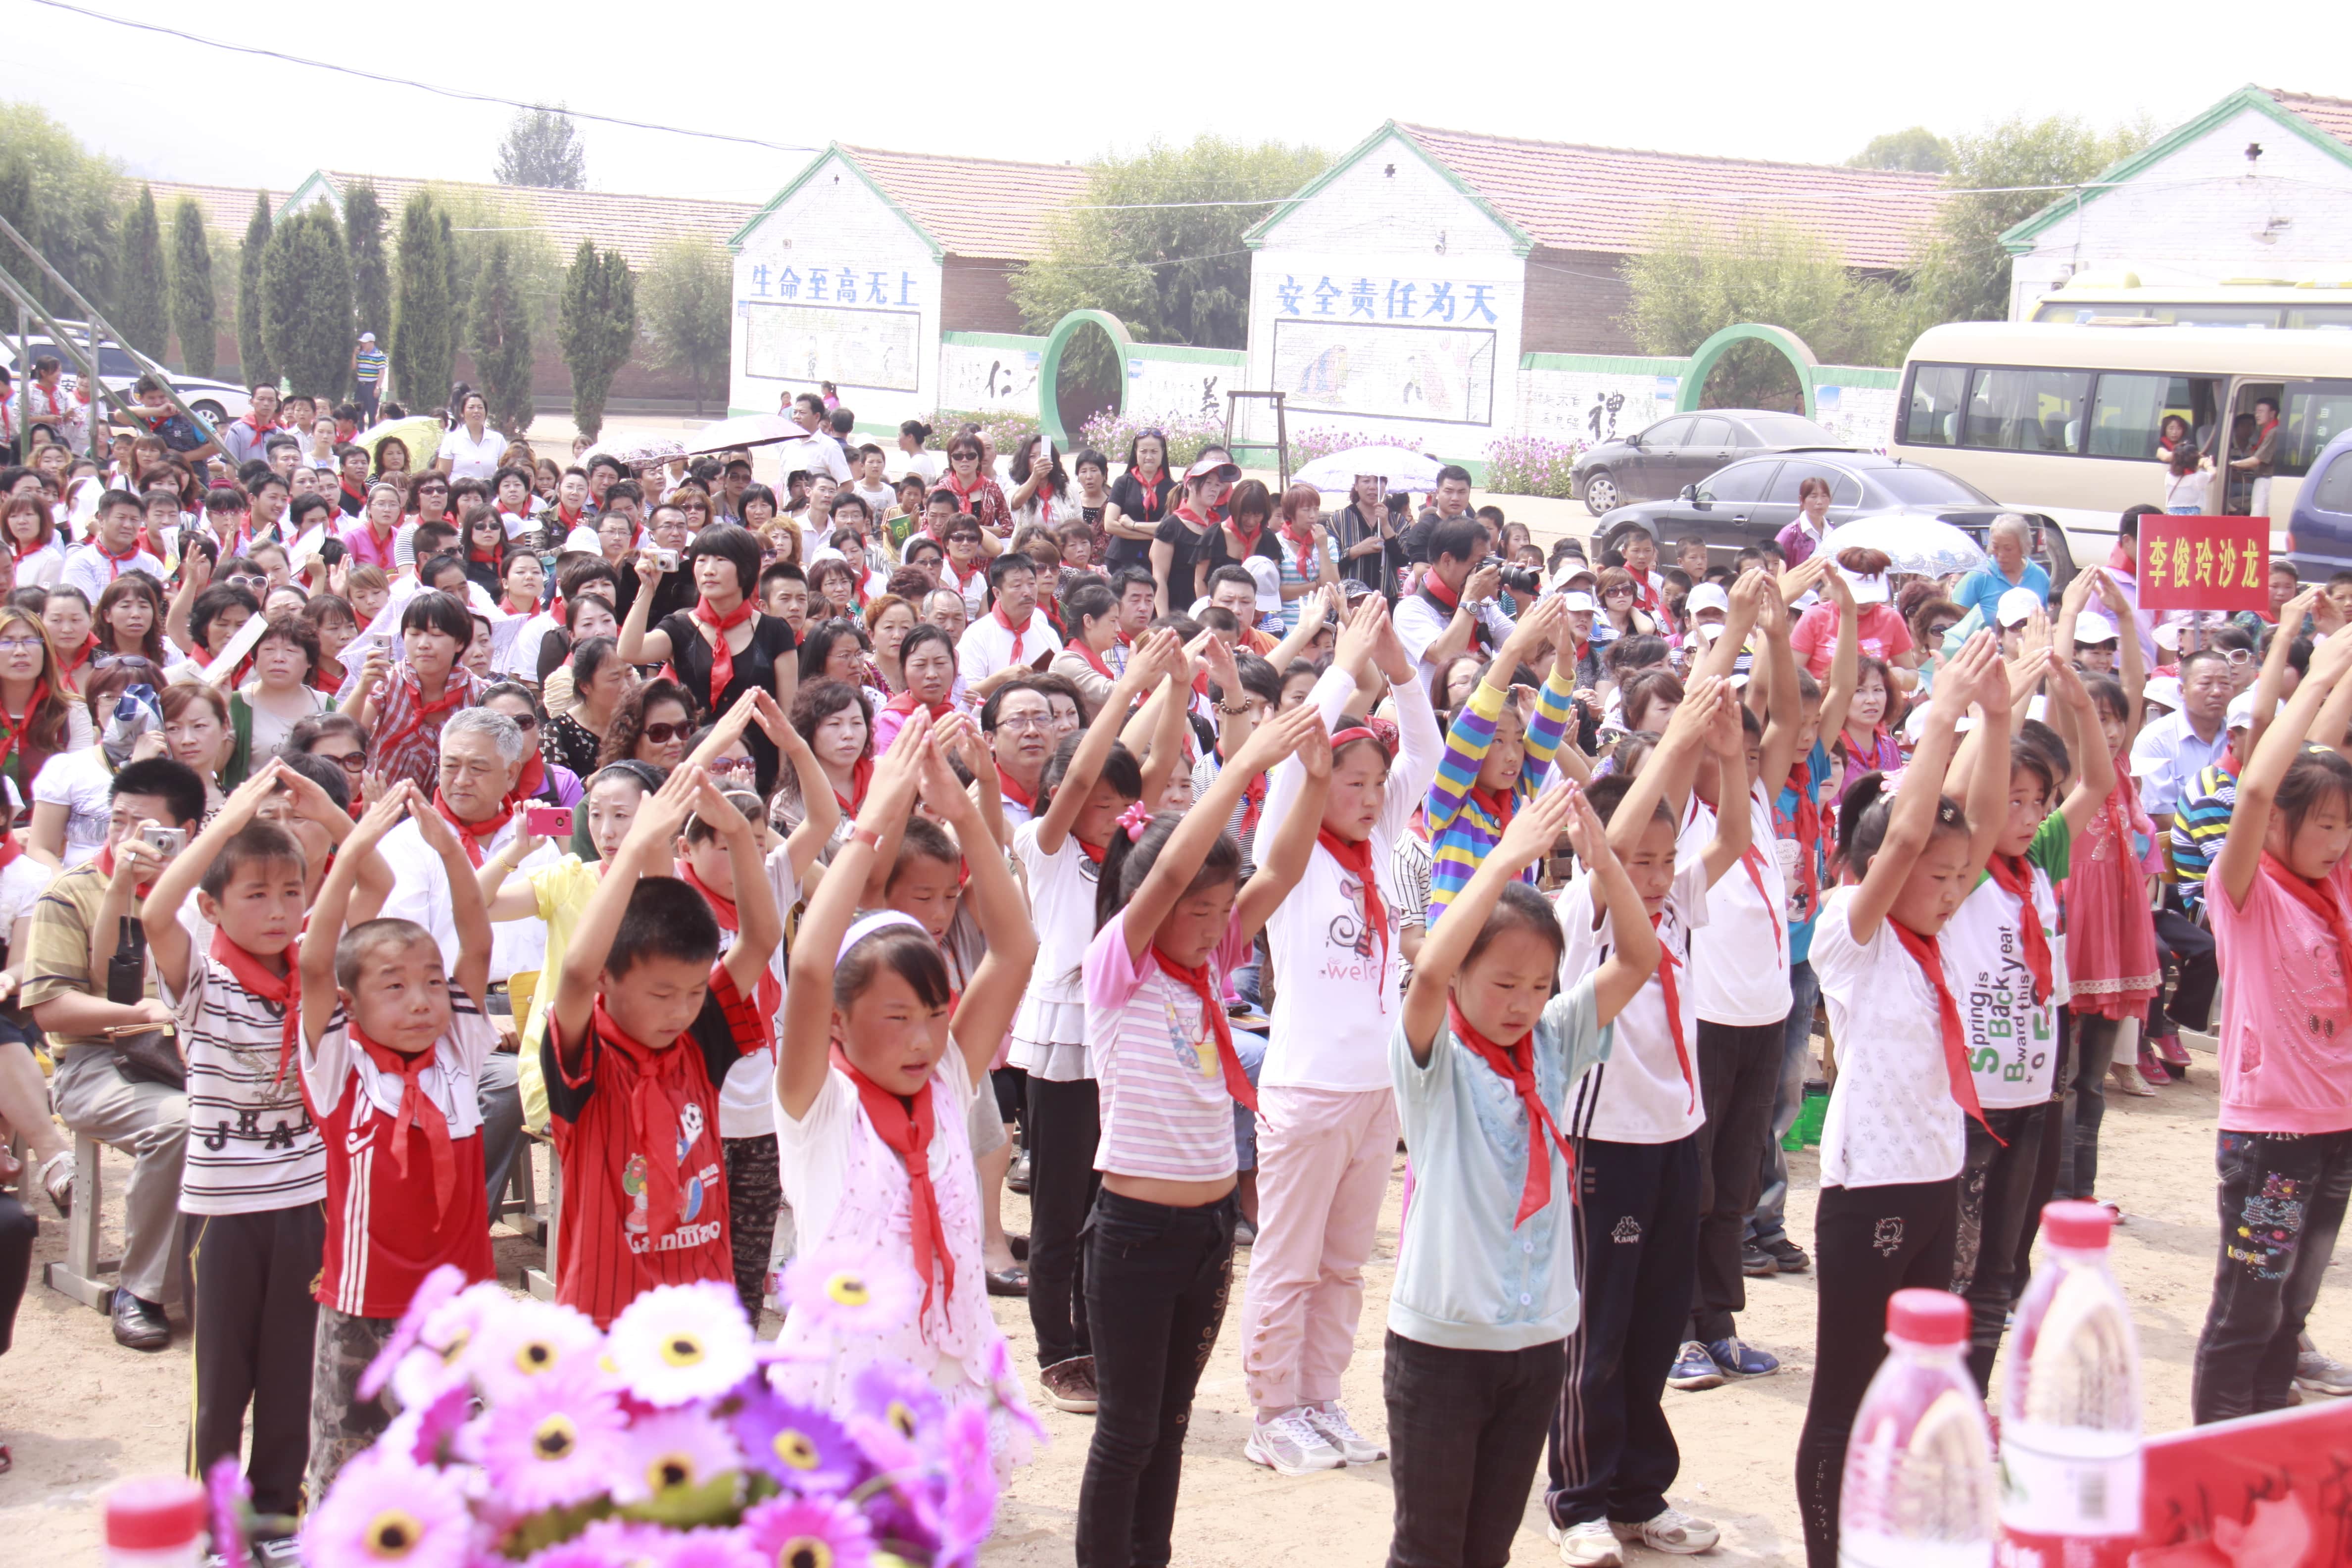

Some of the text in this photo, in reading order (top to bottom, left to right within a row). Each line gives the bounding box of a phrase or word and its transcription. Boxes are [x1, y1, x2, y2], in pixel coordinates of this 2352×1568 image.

[750, 264, 920, 307] 生命至高无上
[1276, 275, 1498, 325] 安全责任为天
[2149, 536, 2259, 588] 李俊玲沙龙
[1988, 976, 2013, 1037] Back
[2017, 975, 2031, 1010] this
[1966, 972, 1999, 1074] Spring is
[2228, 1244, 2266, 1266] LOVE
